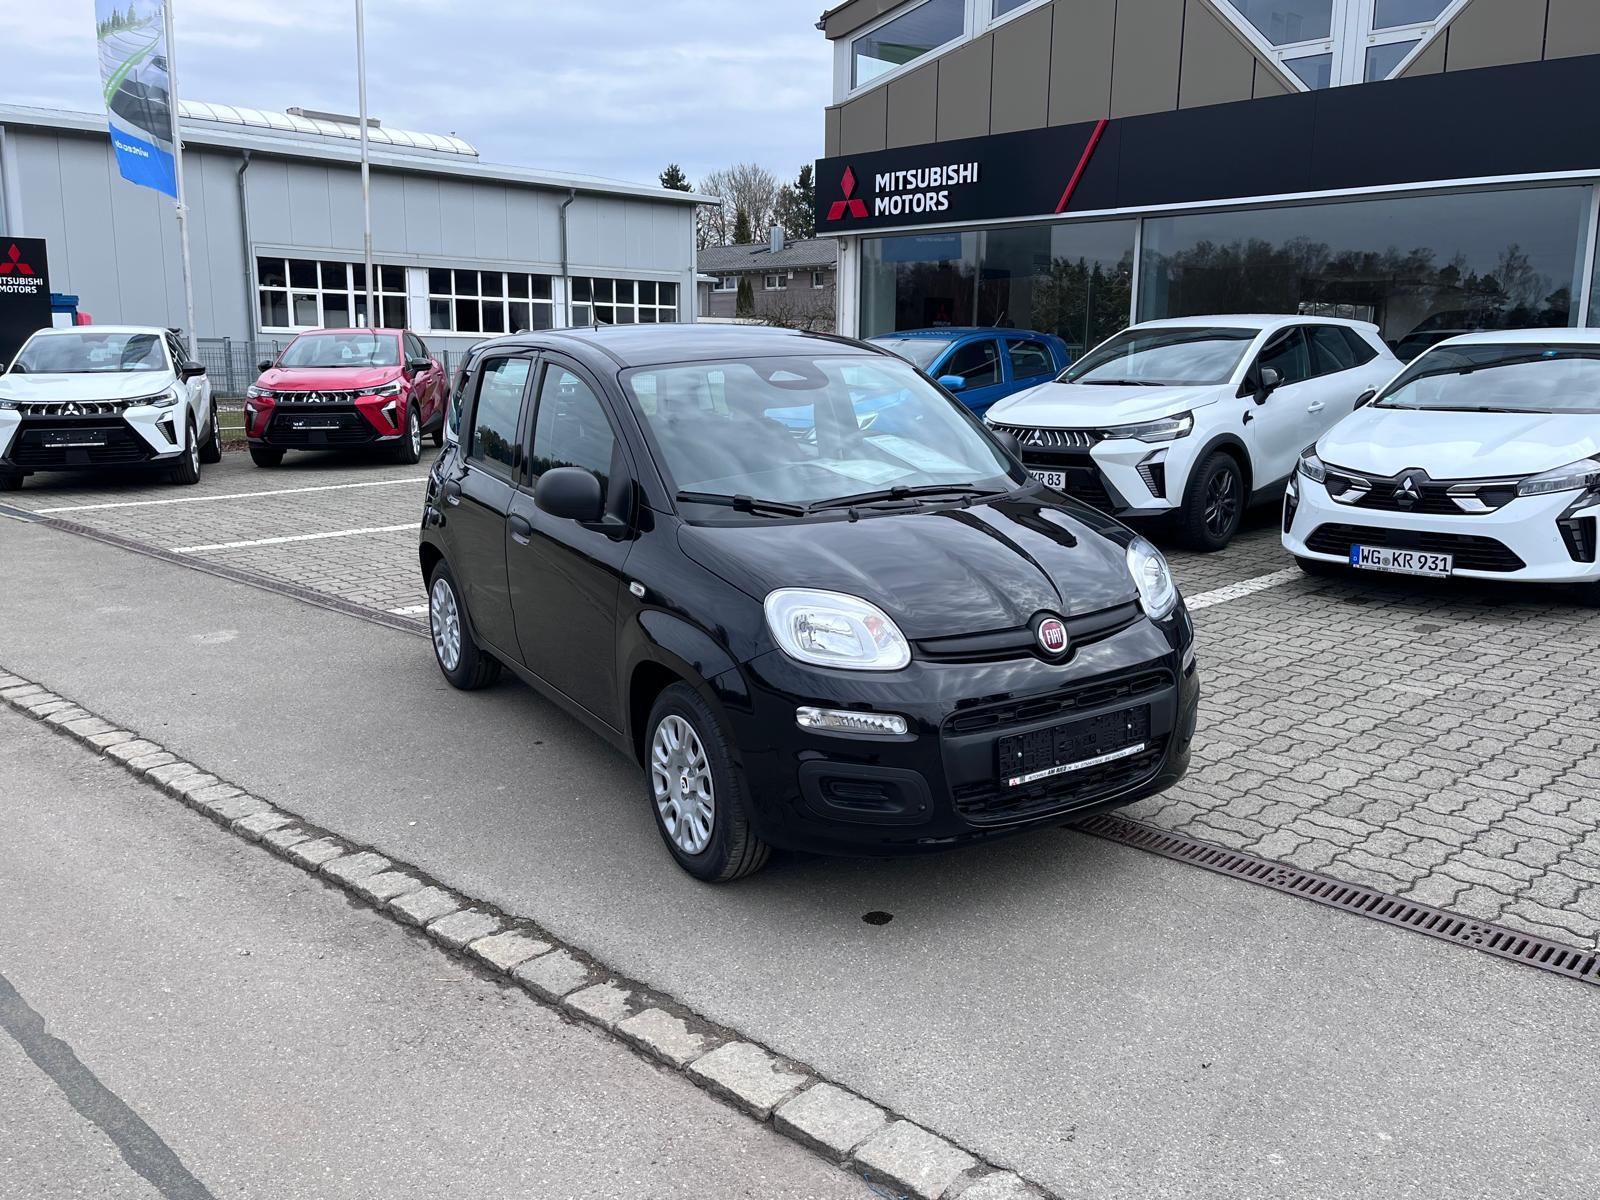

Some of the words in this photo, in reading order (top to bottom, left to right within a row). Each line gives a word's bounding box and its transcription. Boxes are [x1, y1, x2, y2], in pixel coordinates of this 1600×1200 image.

[875, 162, 978, 193] MITSUBISHI
[874, 190, 949, 217] MOTORS
[0, 276, 43, 286] ITSUBISHI
[0, 285, 37, 294] MOTORS
[1047, 473, 1061, 486] 83
[1361, 547, 1381, 565] WG
[1392, 551, 1413, 569] KR
[1417, 554, 1449, 573] 931
[1045, 628, 1062, 645] FIAT
